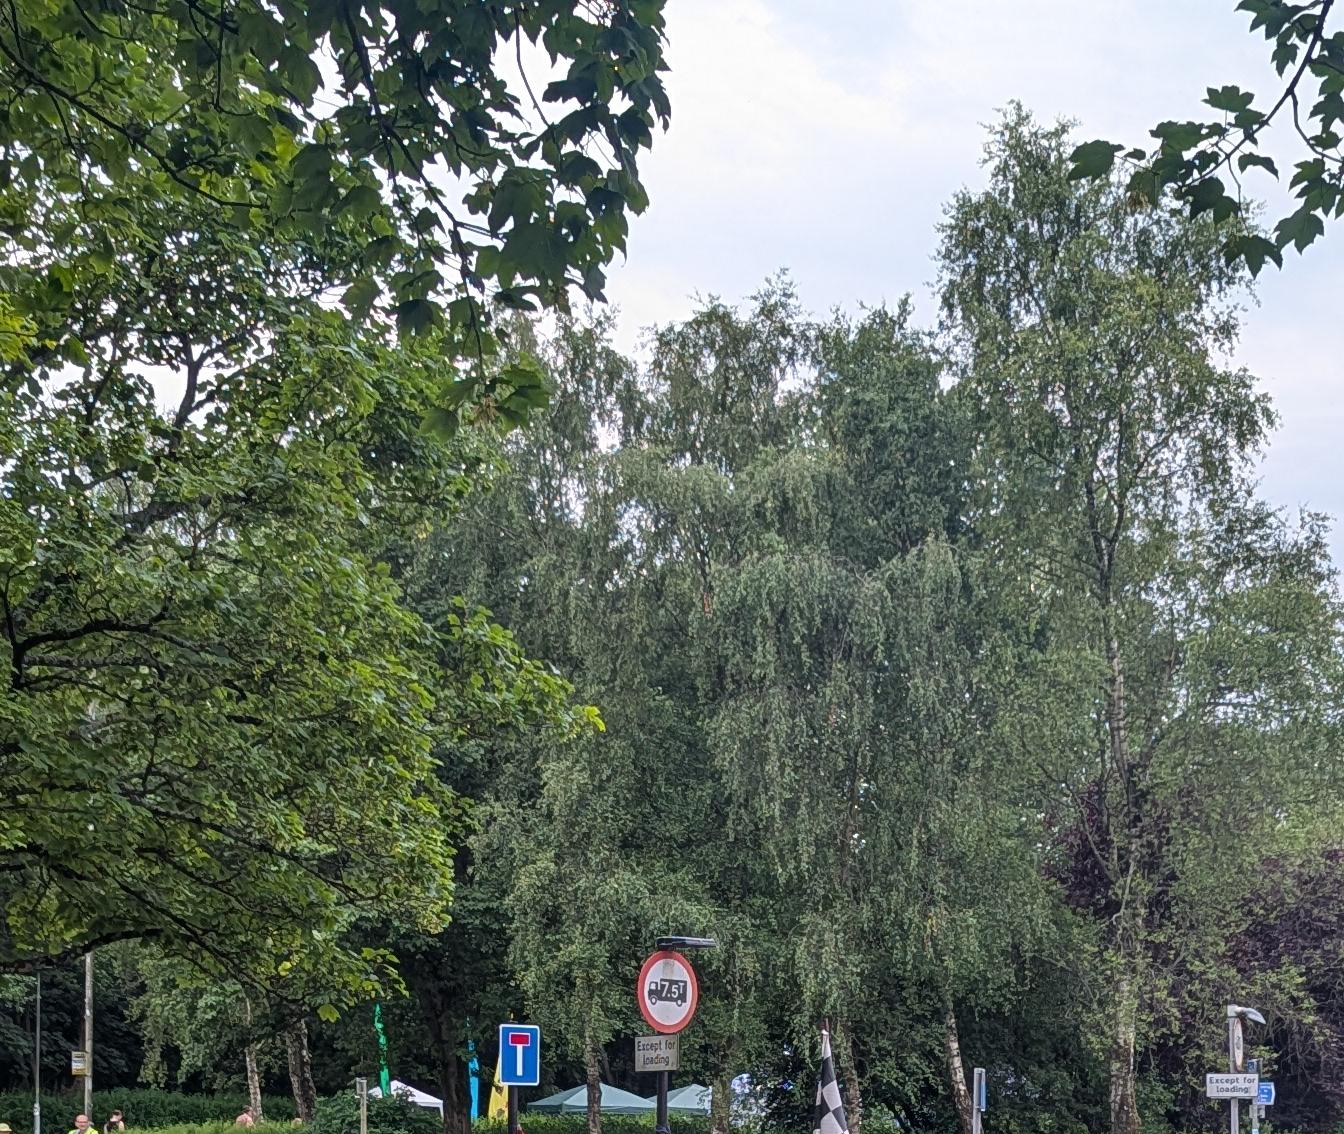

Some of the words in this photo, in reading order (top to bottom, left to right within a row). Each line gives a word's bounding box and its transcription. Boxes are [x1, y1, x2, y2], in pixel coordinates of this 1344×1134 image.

[637, 1040, 662, 1052] Except
[665, 1040, 676, 1050] for
[643, 1054, 669, 1066] loading
[1209, 1077, 1240, 1085] Except
[1216, 1086, 1249, 1094] loading
